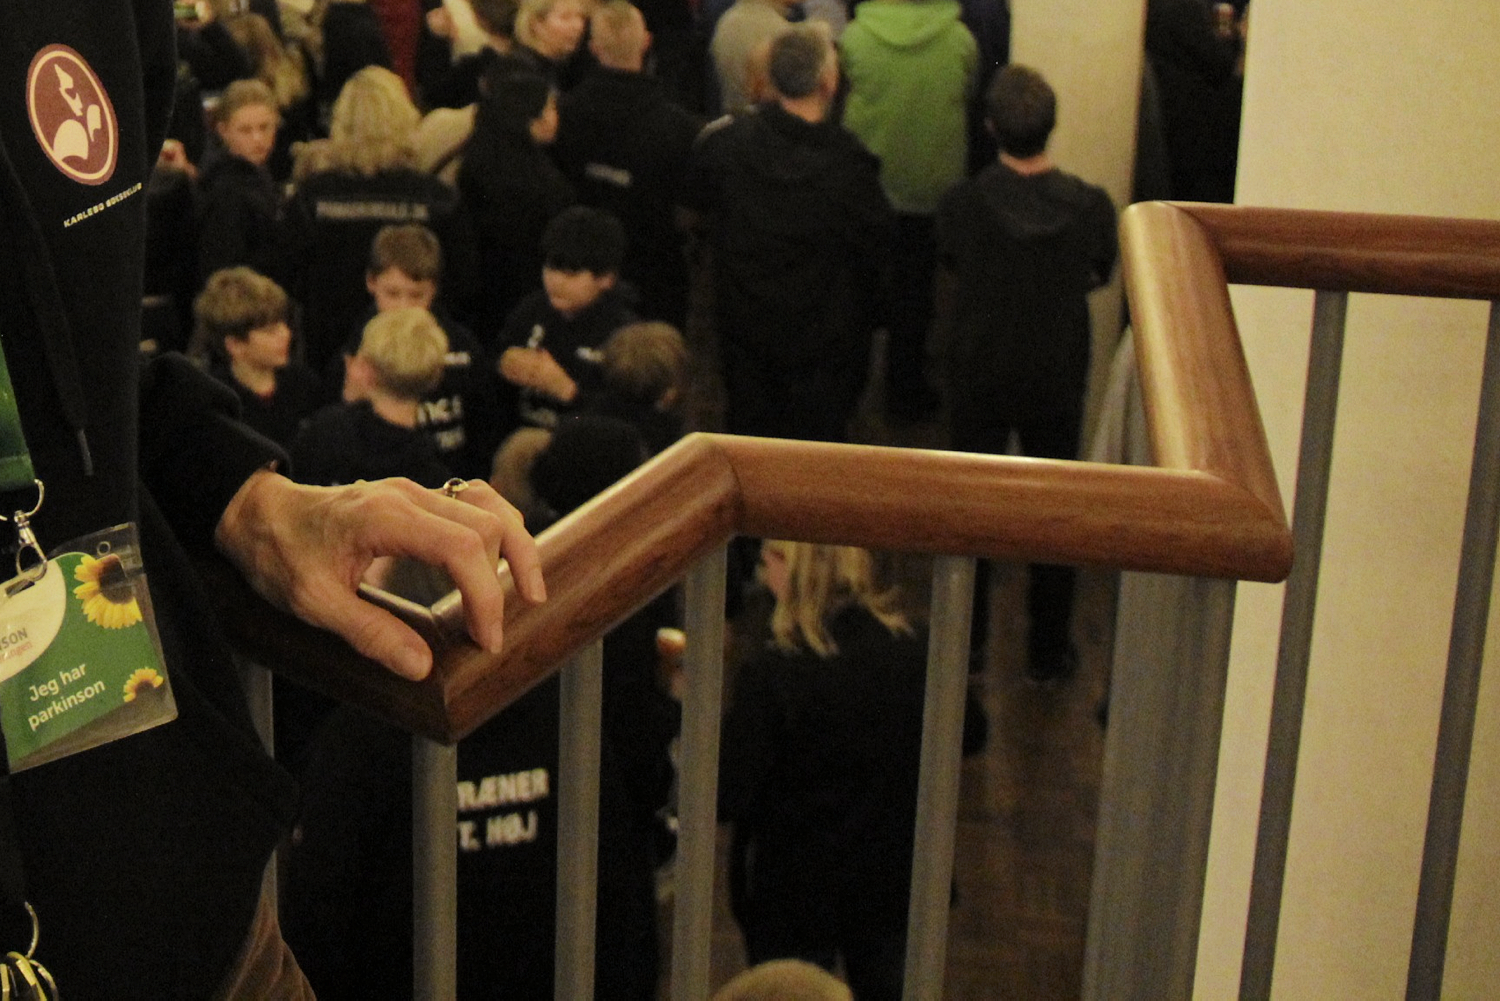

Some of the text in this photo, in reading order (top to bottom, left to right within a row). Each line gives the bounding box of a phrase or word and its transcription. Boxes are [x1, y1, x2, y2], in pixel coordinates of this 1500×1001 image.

[63, 202, 105, 228] KARLEBO
[29, 662, 87, 702] Jeg har
[28, 680, 106, 731] parkinson
